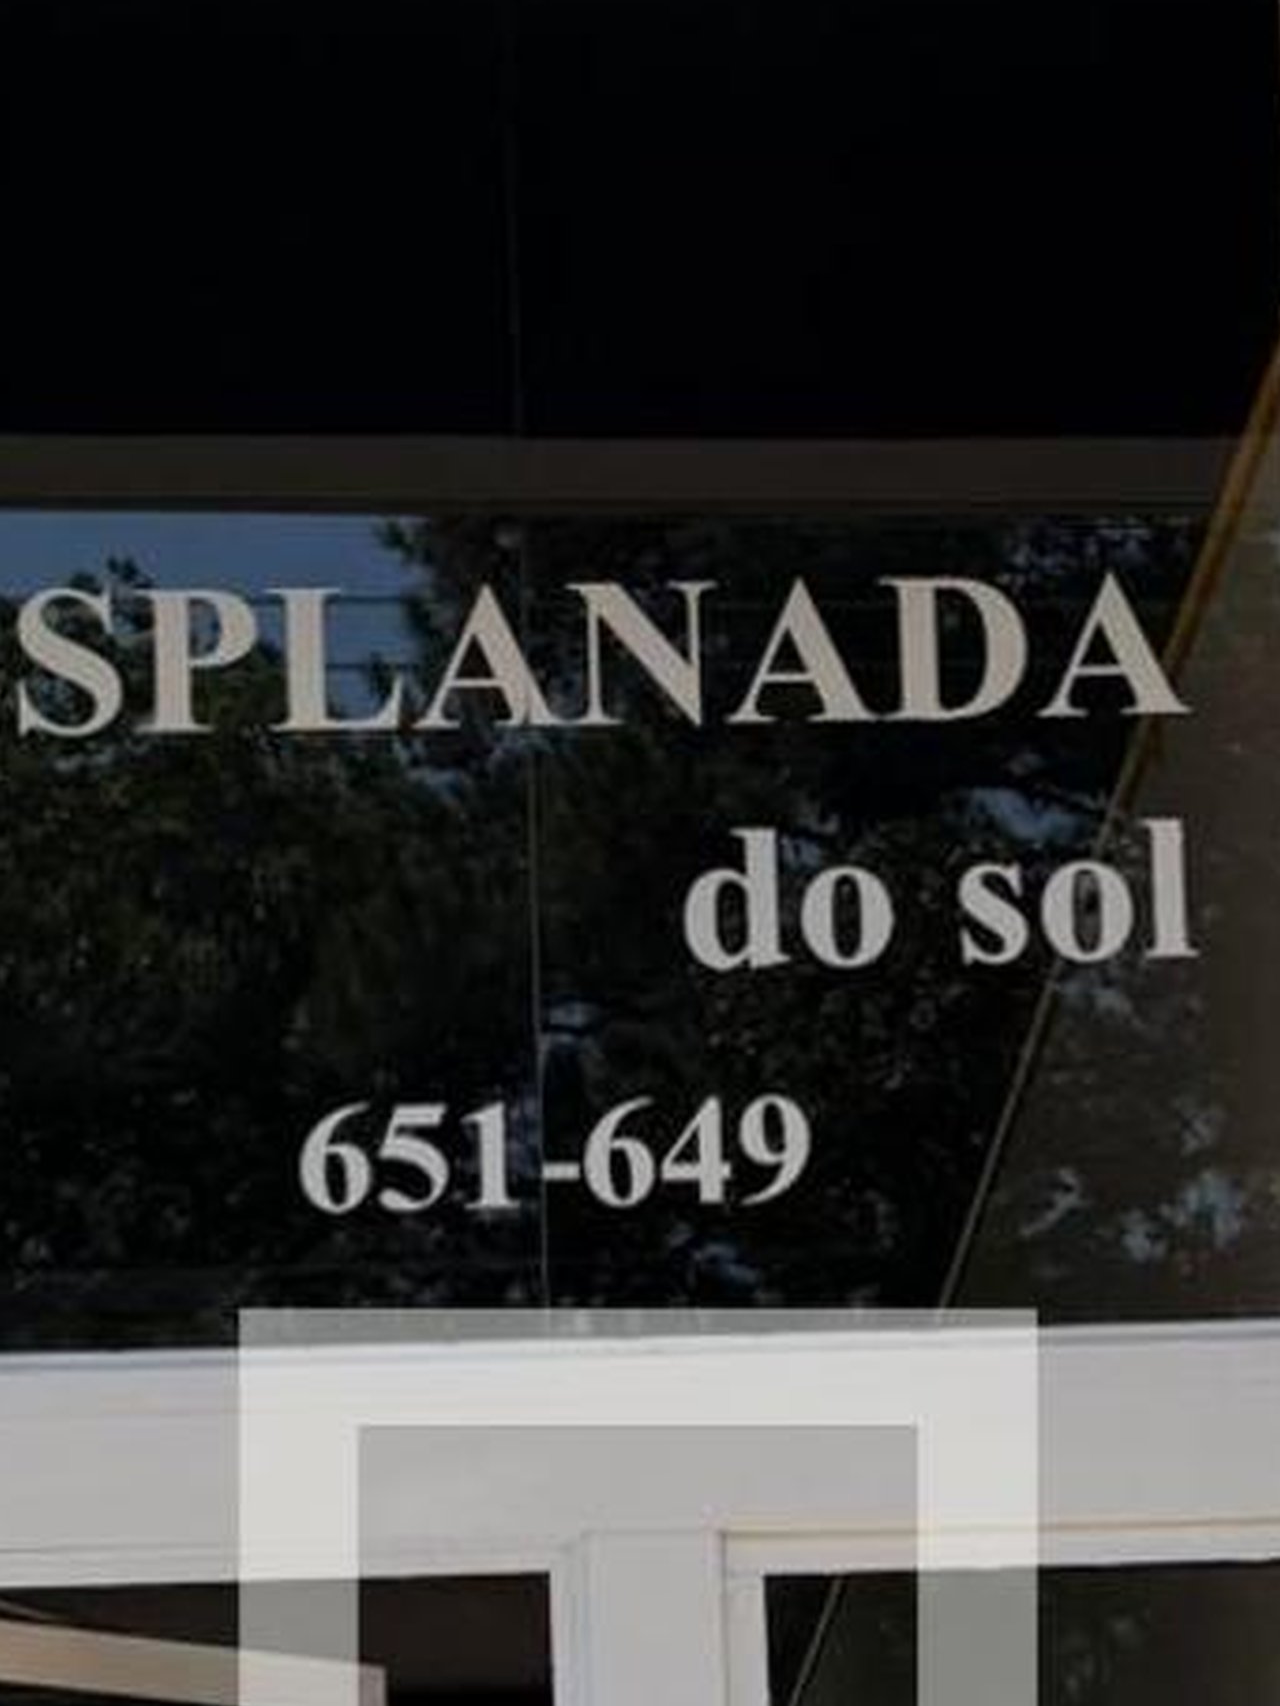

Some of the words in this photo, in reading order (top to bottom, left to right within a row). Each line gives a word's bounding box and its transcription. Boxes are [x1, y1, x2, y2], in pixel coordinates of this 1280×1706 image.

[682, 827, 894, 971] do
[958, 818, 1199, 965] sol
[299, 1094, 811, 1215] 651-649
